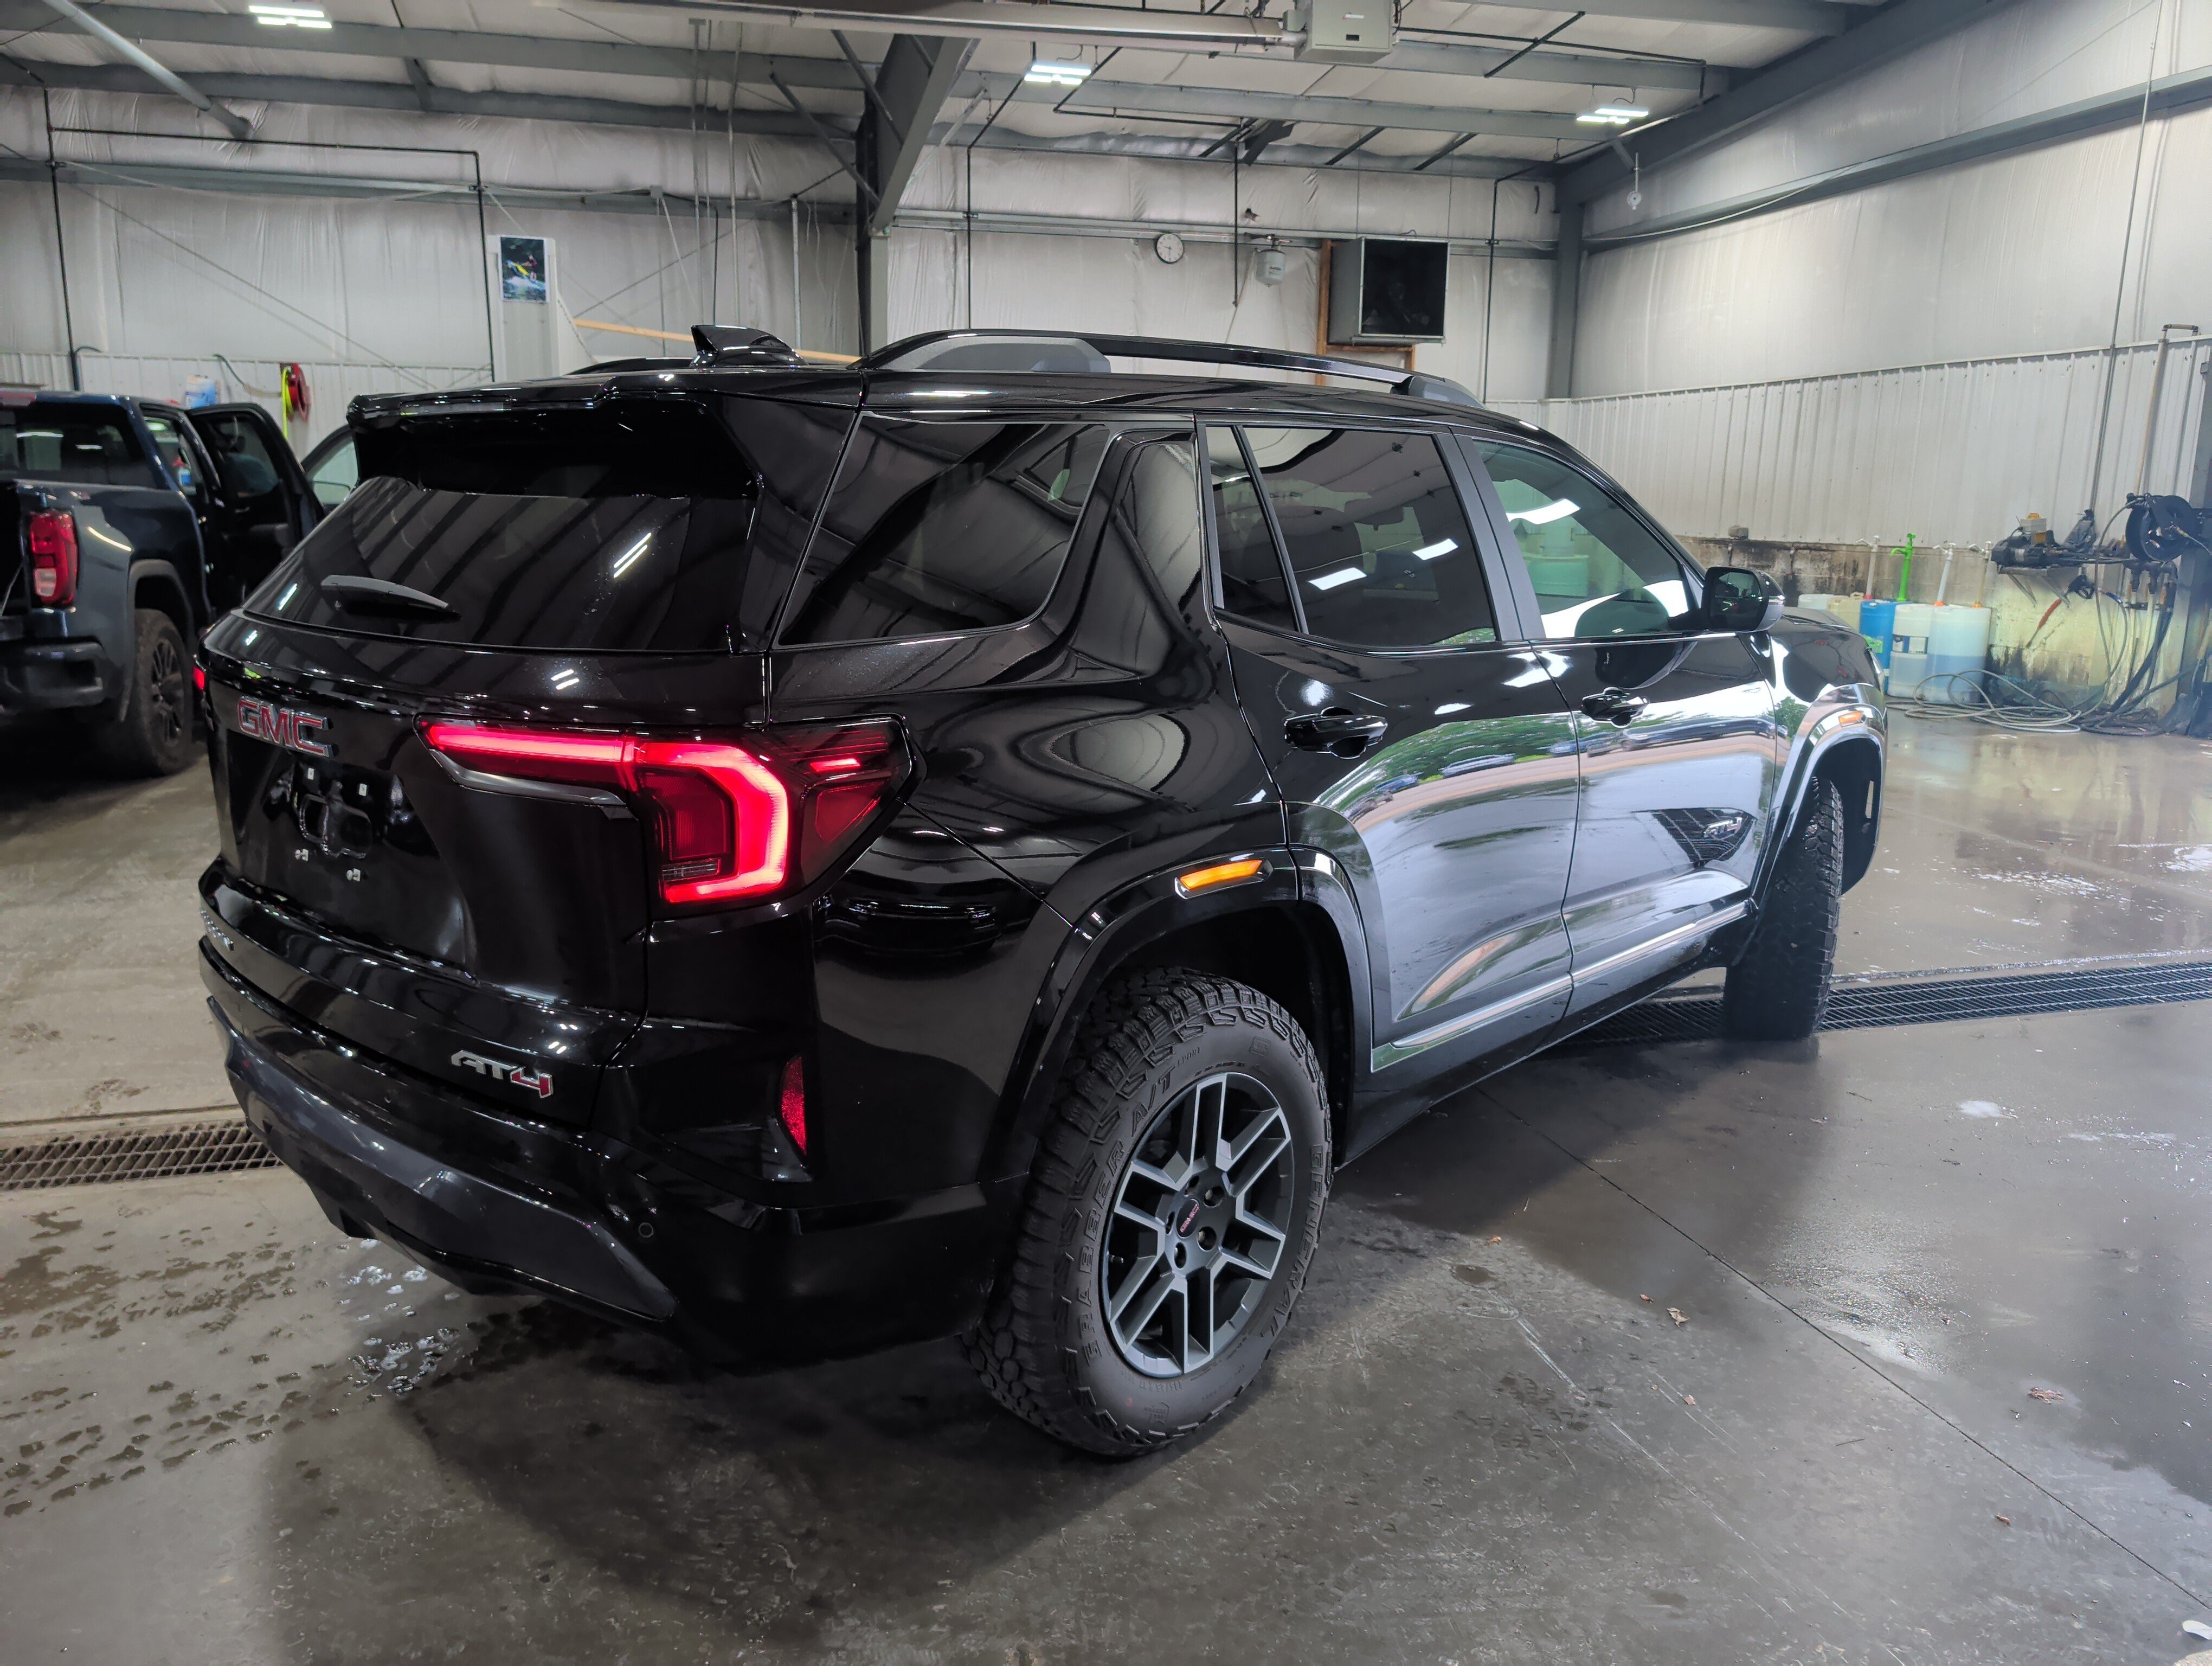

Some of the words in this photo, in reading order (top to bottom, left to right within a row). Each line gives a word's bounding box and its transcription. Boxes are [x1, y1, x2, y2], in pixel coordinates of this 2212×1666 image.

[237, 695, 333, 757] GMC
[1703, 816, 1742, 838] AT4
[451, 1049, 554, 1098] AT4
[1079, 1140, 1126, 1366] GRABBER
[1131, 1065, 1176, 1137] A/T
[1261, 1133, 1324, 1337] GENERAL
